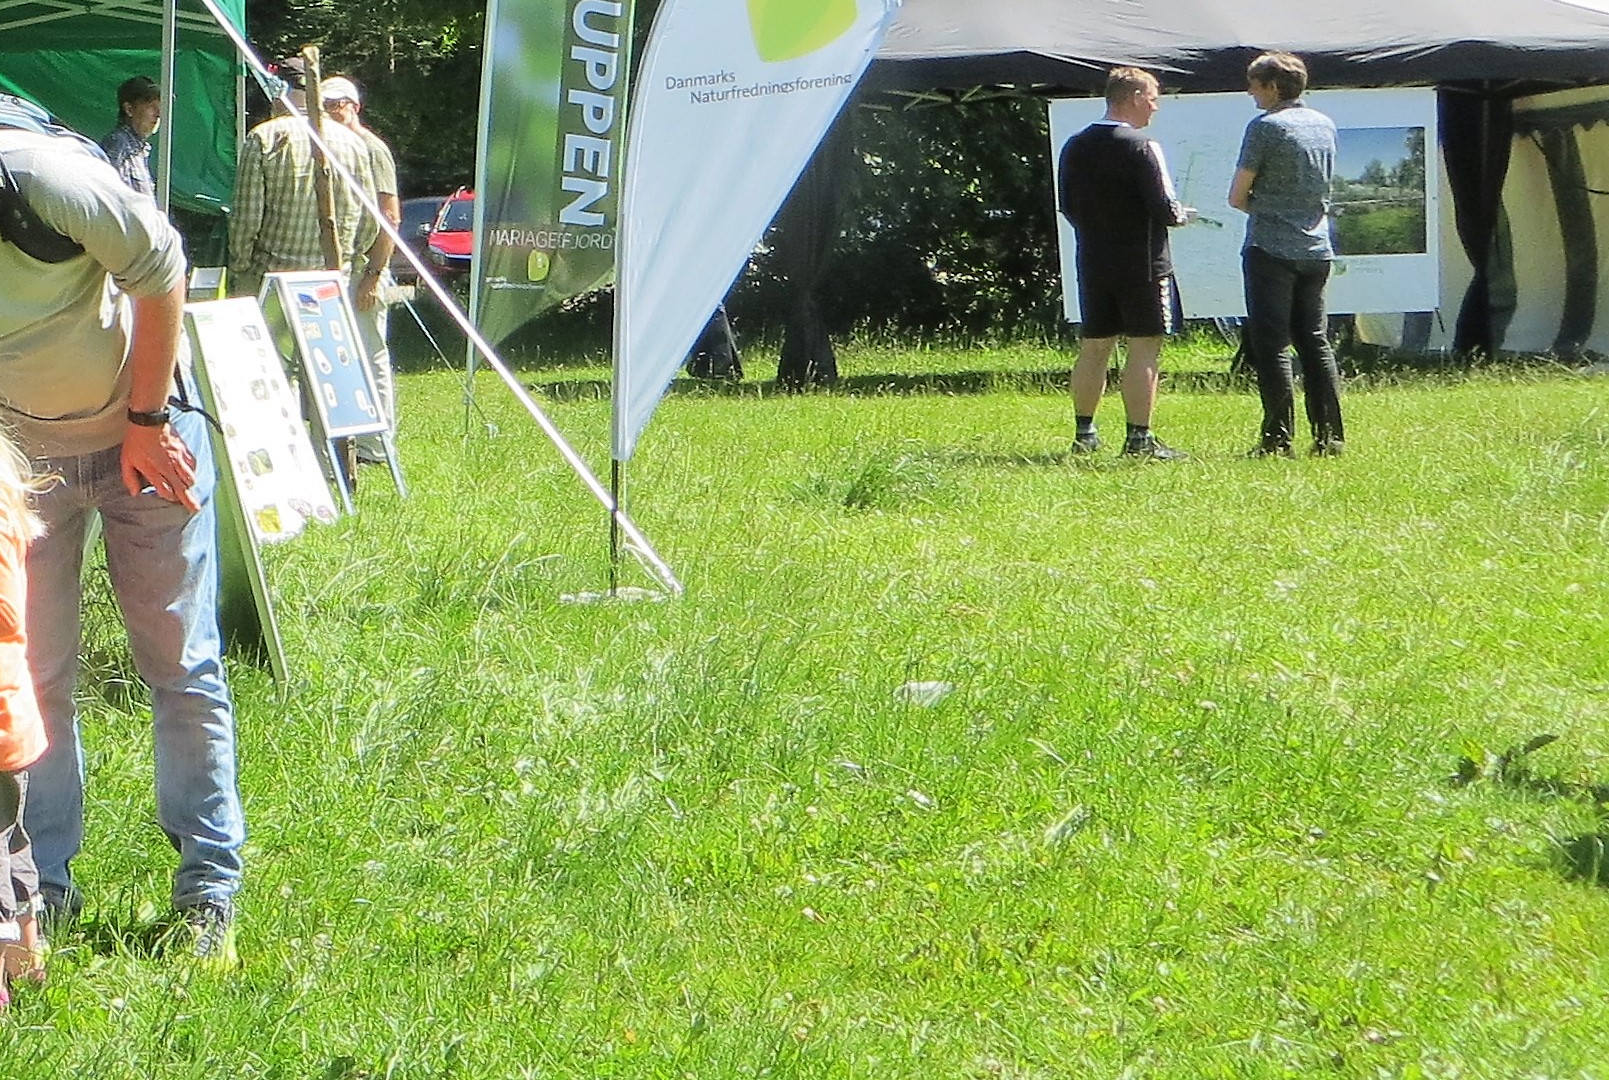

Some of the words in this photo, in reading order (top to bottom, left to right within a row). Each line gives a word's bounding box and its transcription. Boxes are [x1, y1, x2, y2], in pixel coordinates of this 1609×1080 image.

[665, 69, 736, 91] Danmarks
[690, 73, 853, 105] Naturfredningsforening
[489, 228, 613, 250] MARIAGEFJORD
